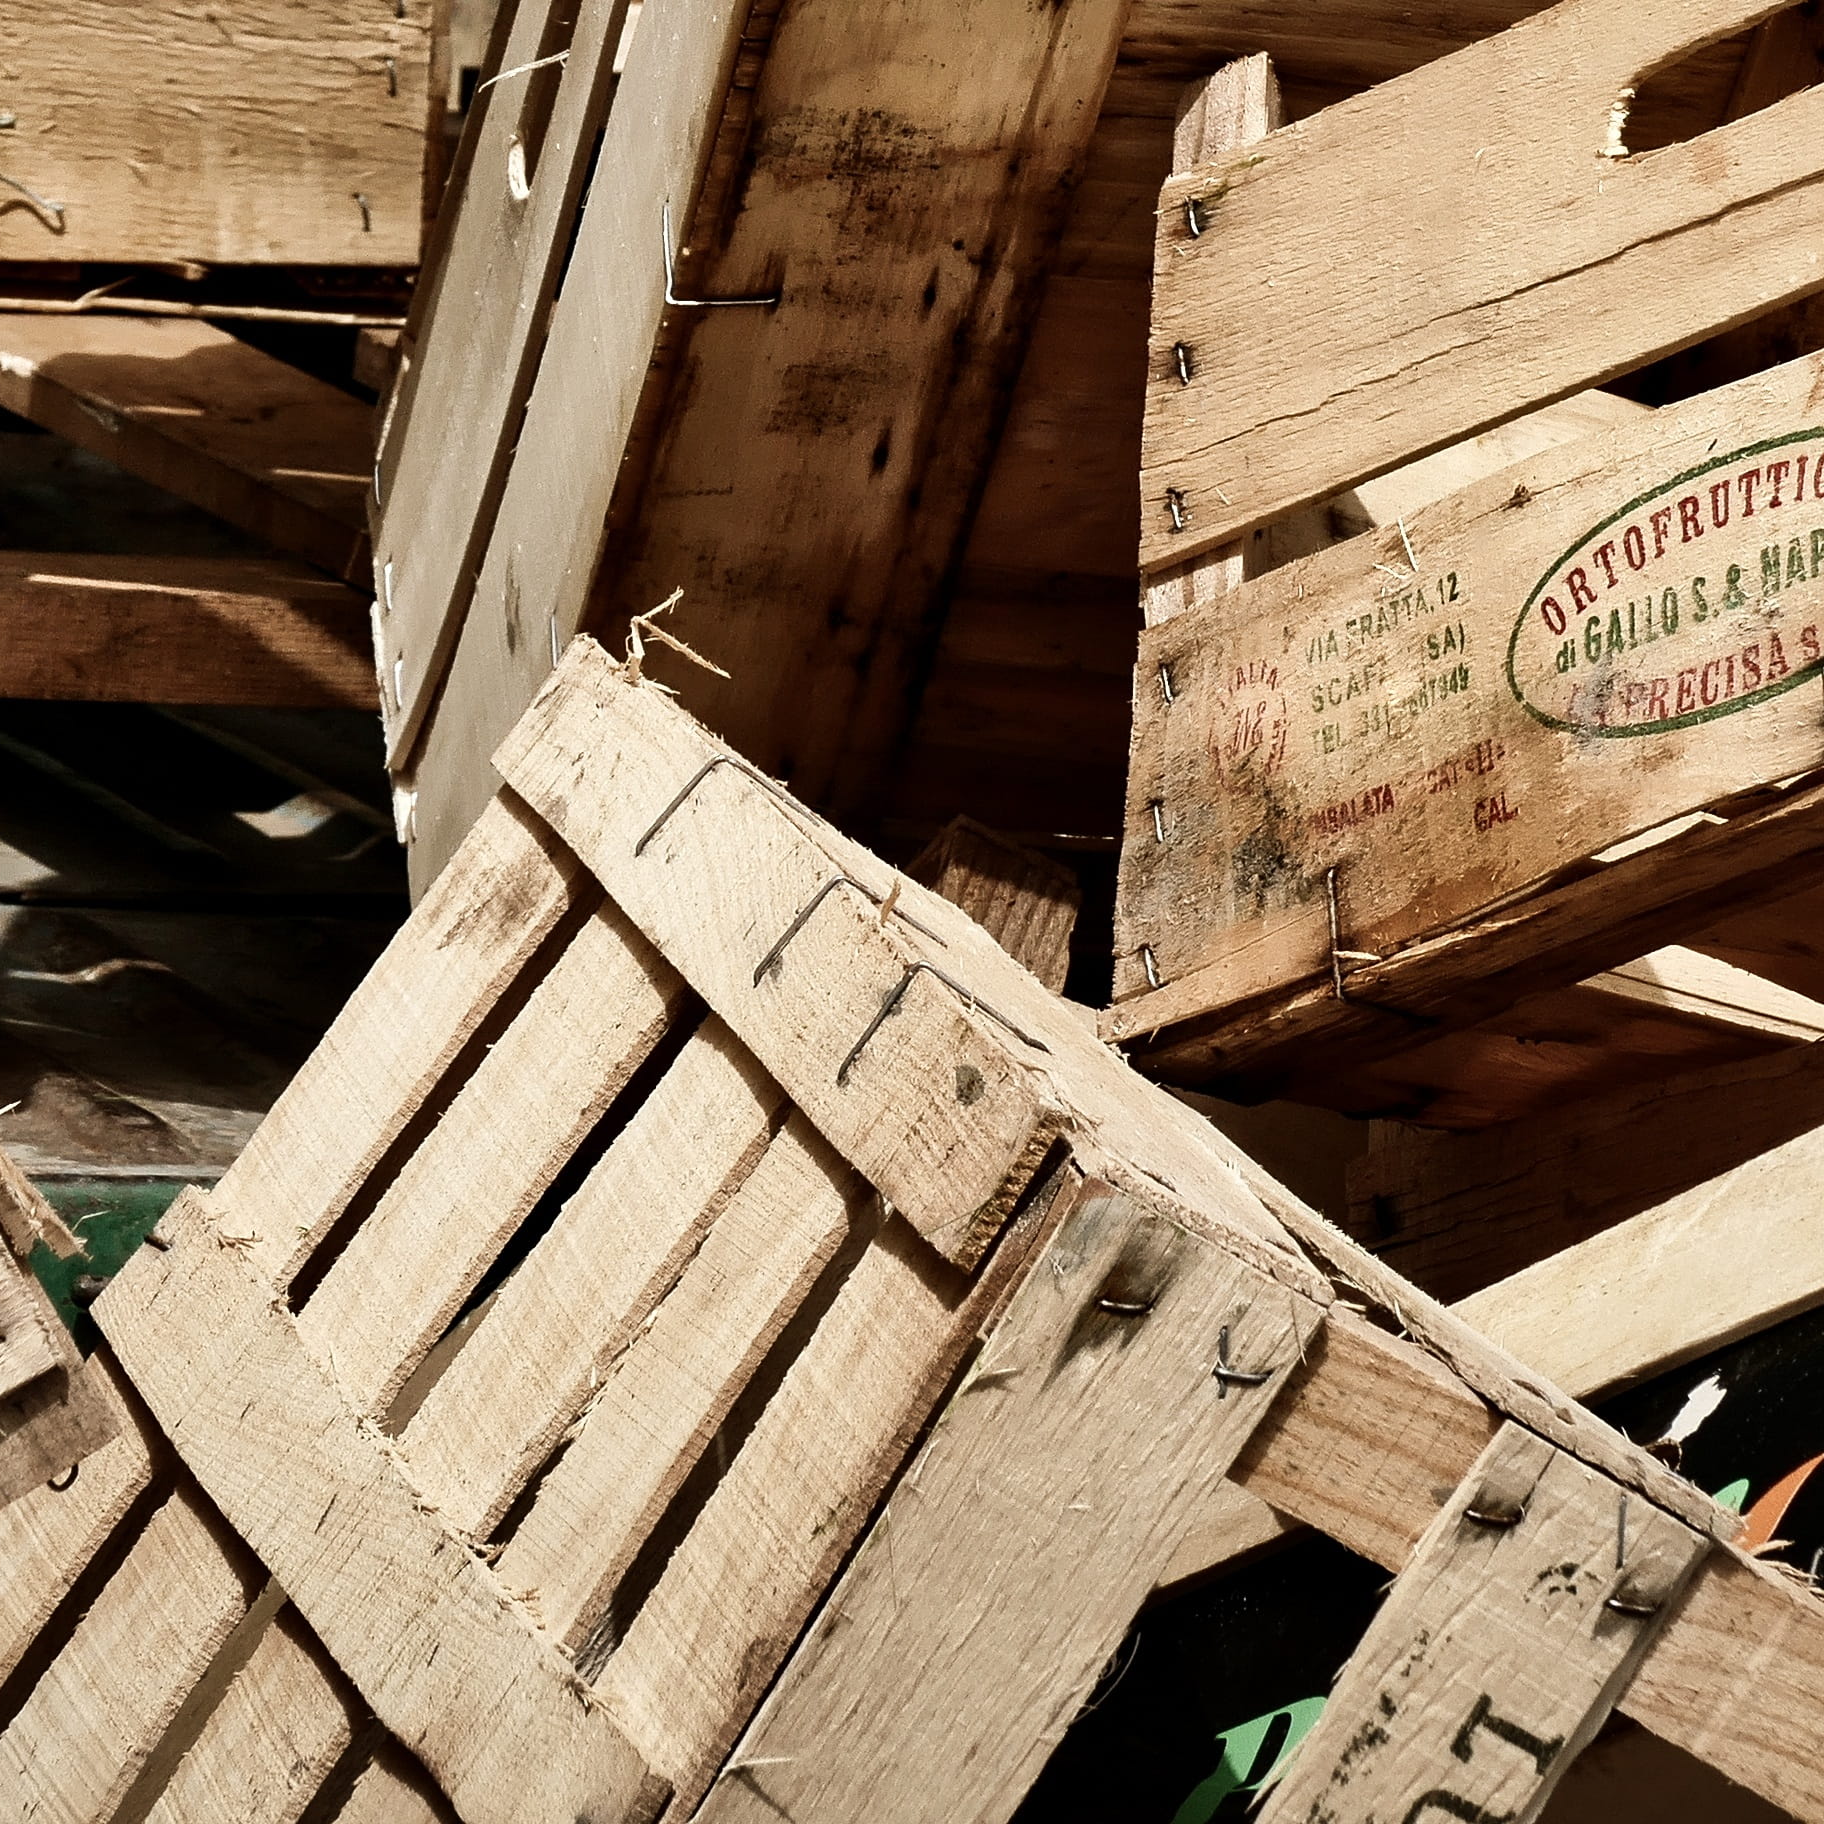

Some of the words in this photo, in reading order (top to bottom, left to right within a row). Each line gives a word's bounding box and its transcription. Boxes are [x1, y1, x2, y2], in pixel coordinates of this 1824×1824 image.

[1556, 639, 1576, 674] di
[1584, 587, 1680, 664] GALLO
[1722, 562, 1750, 610] &
[1305, 629, 1340, 665] VIA
[1423, 622, 1466, 661] SA)
